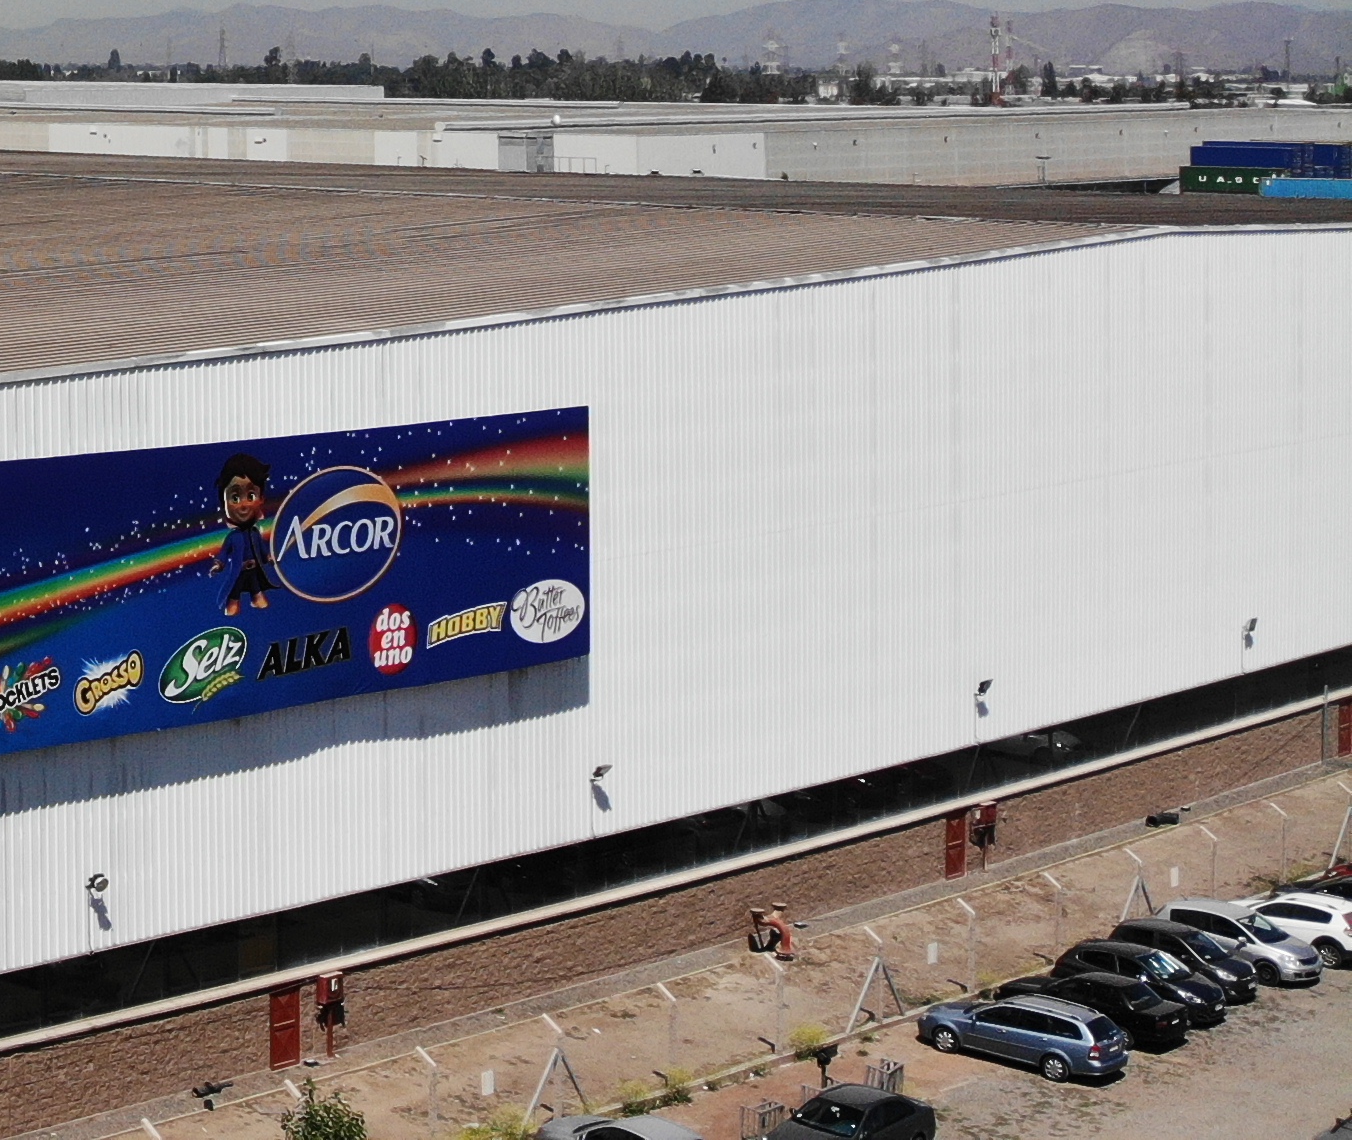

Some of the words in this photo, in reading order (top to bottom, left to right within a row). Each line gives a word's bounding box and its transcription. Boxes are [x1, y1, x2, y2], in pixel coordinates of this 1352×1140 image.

[277, 515, 395, 562] ARCOR
[376, 608, 411, 632] dos
[430, 604, 504, 644] HOBBY
[510, 585, 566, 628] Butter
[536, 605, 581, 642] Toffees
[257, 626, 351, 680] ALKA
[374, 646, 413, 668] uno
[381, 629, 406, 649] en
[164, 634, 243, 697] Selz
